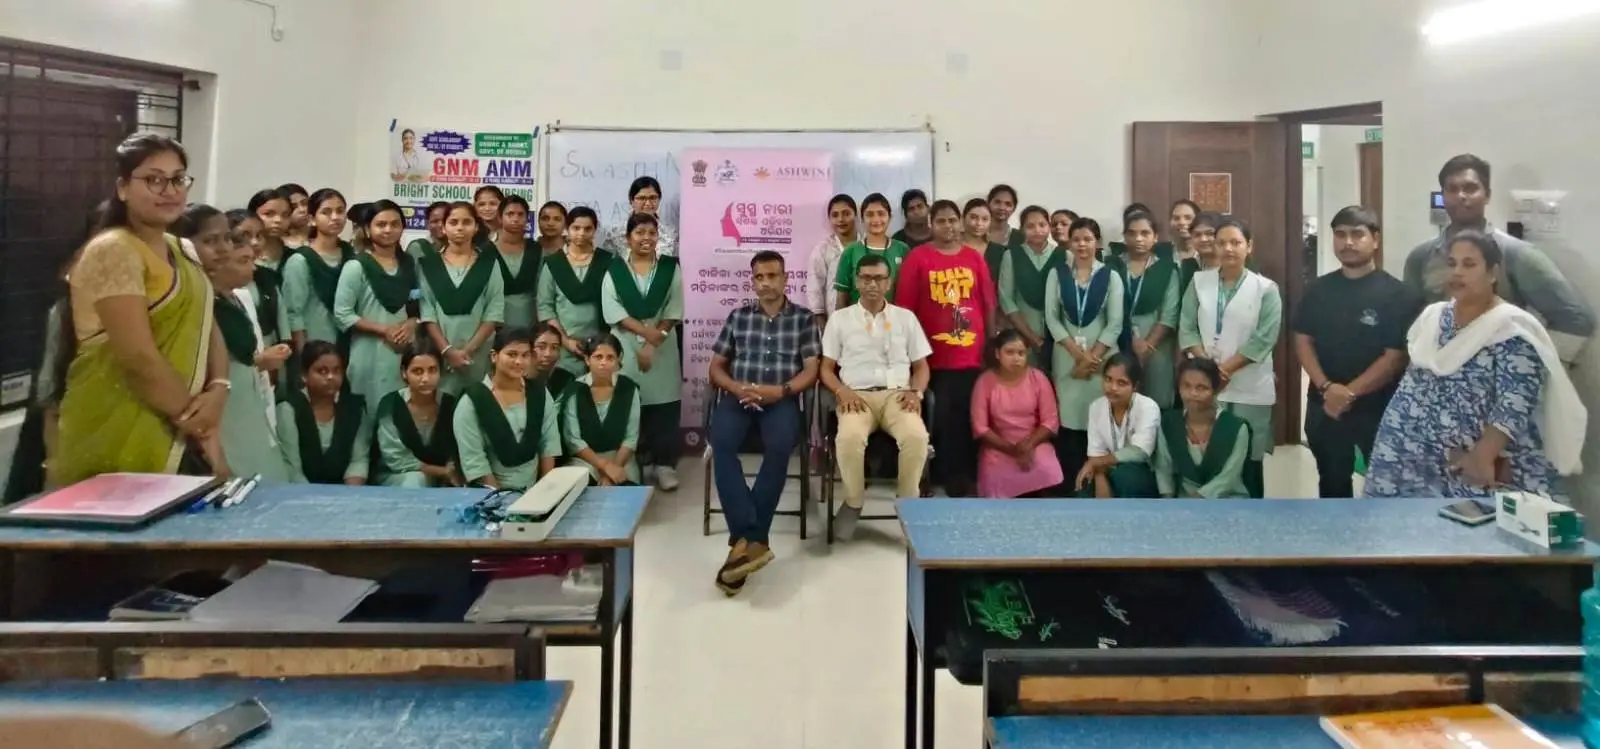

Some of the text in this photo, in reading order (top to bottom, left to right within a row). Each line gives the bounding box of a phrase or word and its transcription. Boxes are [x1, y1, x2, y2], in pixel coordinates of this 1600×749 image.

[433, 158, 532, 178] GNM ANM
[776, 166, 831, 177] ASHWINI
[393, 183, 430, 198] BRIGHT
[432, 185, 473, 200] SCHOOL
[930, 280, 974, 305] HOT
